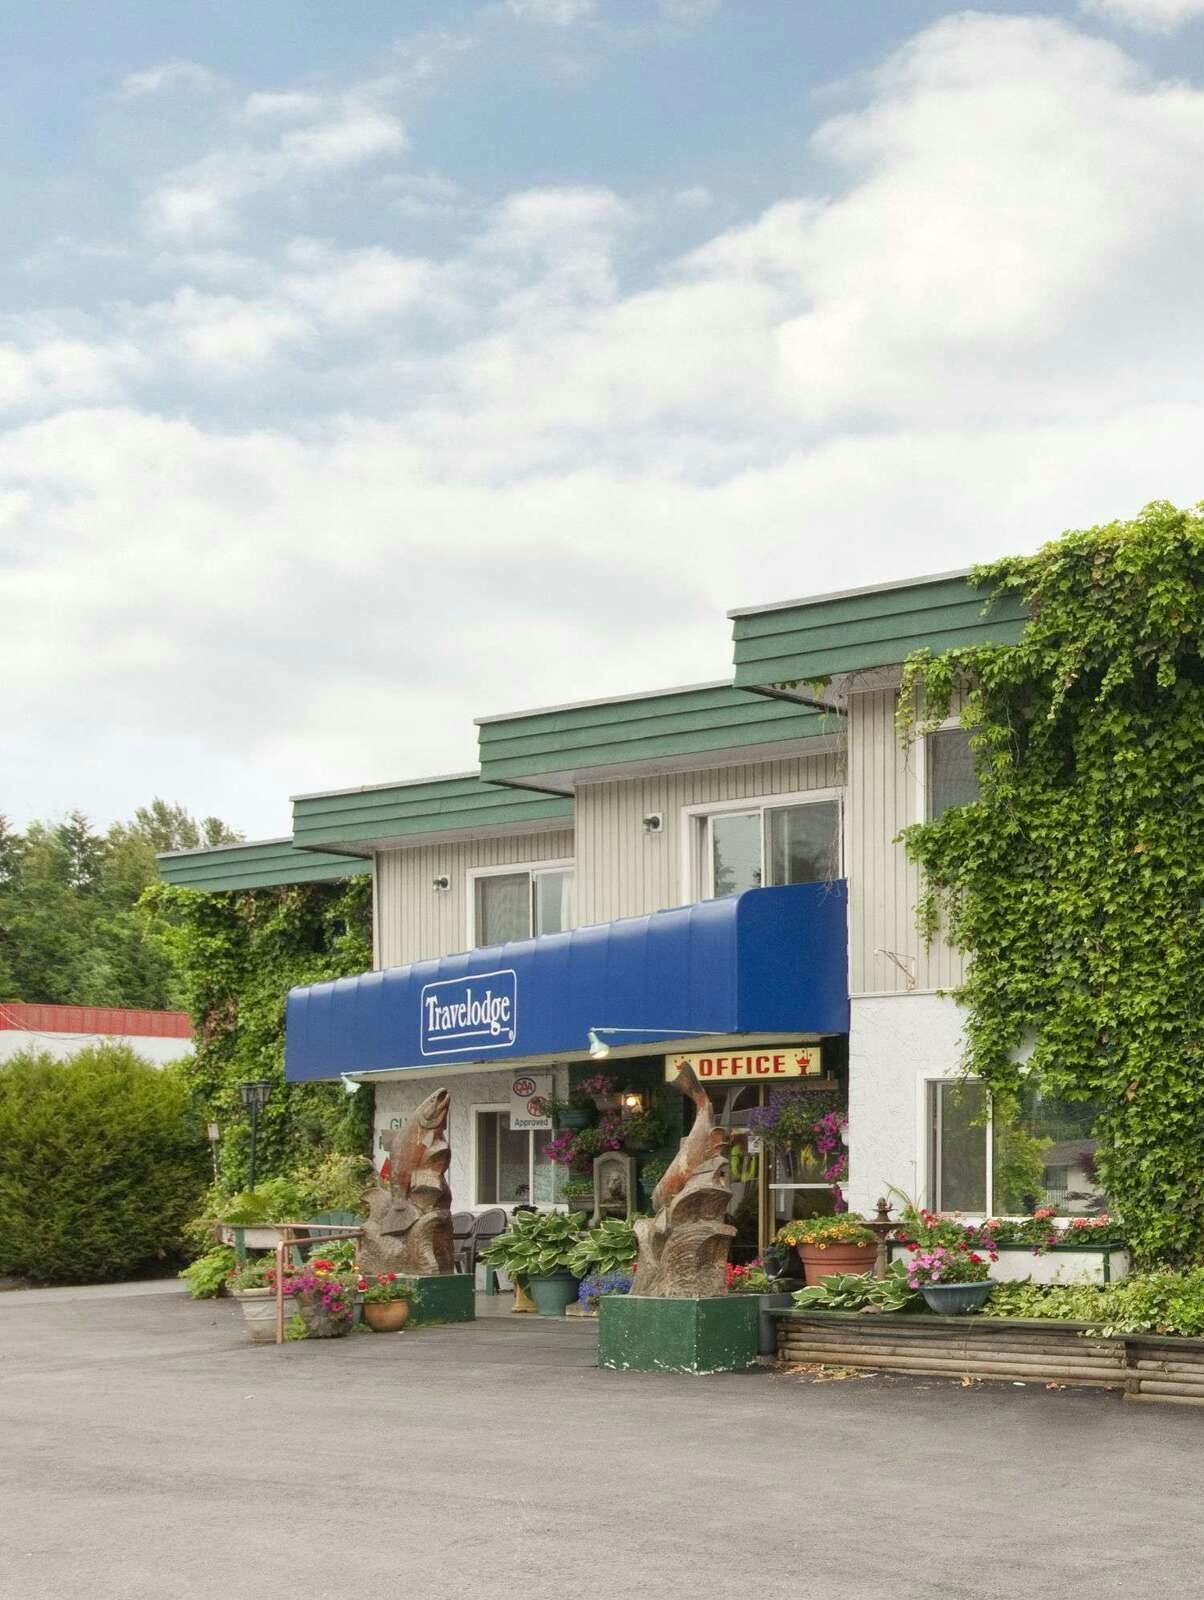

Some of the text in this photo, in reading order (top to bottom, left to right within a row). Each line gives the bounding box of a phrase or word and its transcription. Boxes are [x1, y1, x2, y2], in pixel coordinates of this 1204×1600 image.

[425, 988, 511, 1036] Travelodge
[699, 1055, 786, 1077] OFFICE
[514, 1118, 549, 1128] Approved
